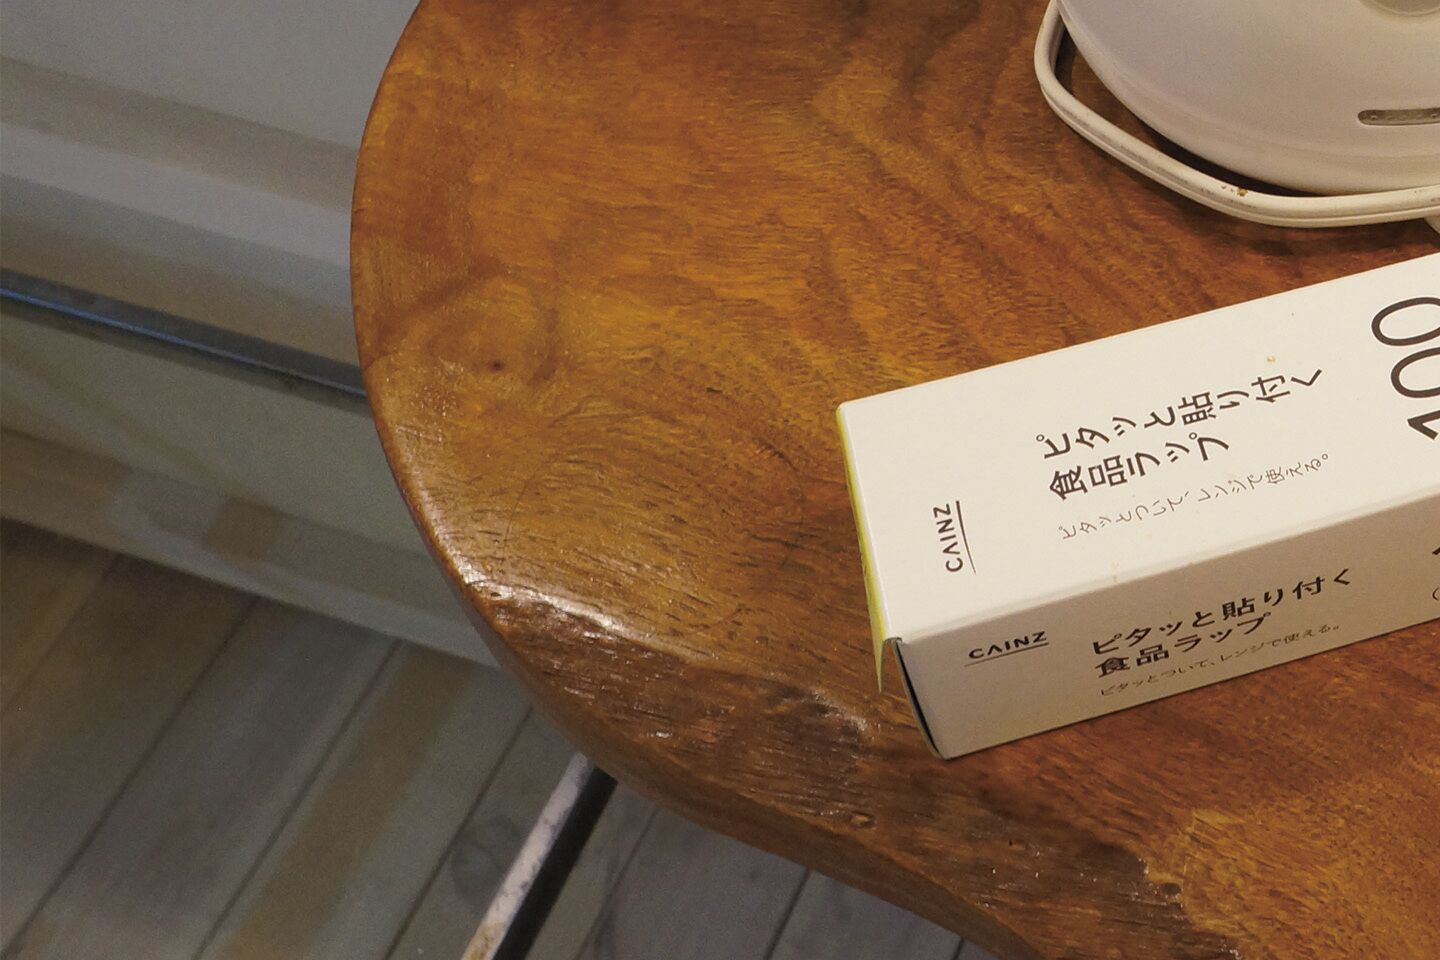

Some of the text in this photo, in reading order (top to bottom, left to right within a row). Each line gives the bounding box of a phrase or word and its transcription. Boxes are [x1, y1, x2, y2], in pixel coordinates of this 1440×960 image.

[1035, 368, 1323, 460] ピタッと貼り付く
[1049, 431, 1230, 501] 食品ラップ
[932, 502, 964, 573] CAINZ
[967, 630, 1048, 661] CAINZ
[1092, 568, 1351, 656] ピタッと貼り付く
[1094, 611, 1272, 678] 食品ラップ
